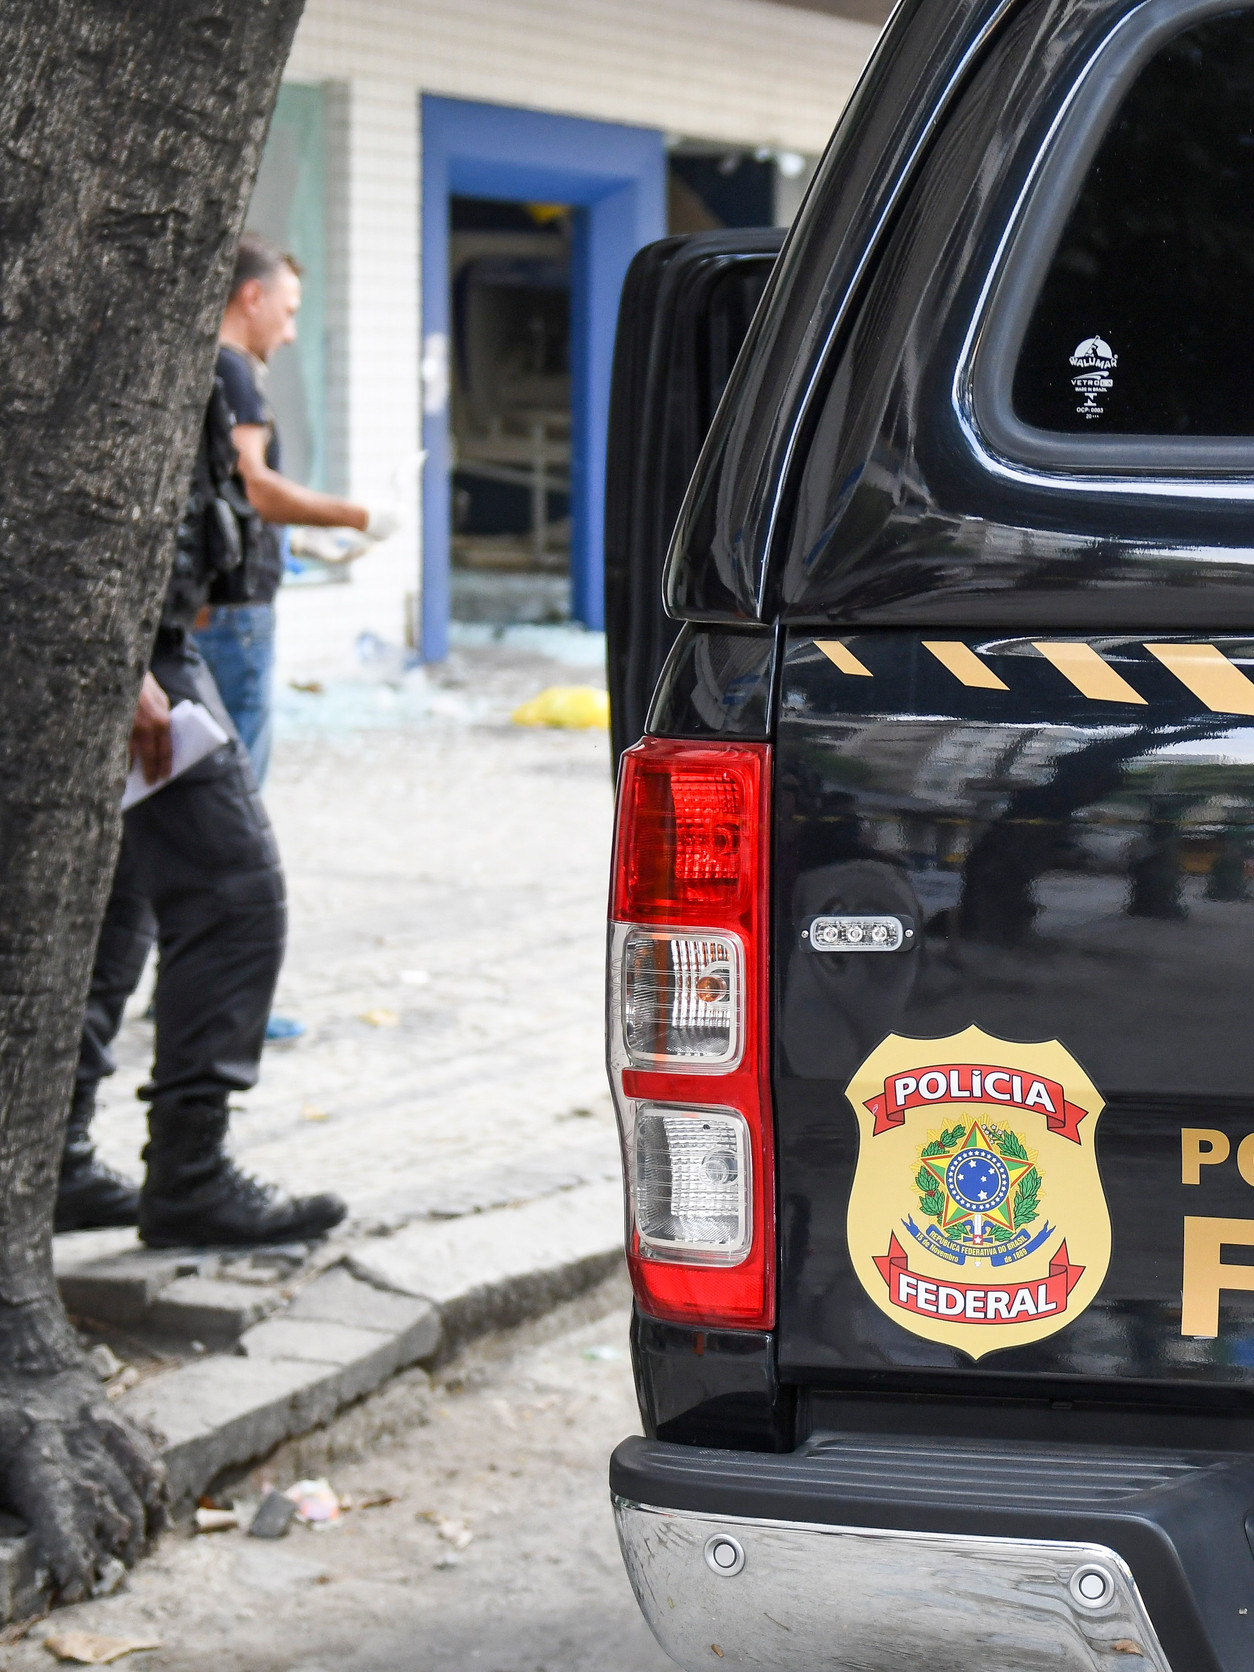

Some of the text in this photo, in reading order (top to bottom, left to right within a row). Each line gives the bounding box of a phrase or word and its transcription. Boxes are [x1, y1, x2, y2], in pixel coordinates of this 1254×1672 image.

[1069, 355, 1117, 369] WALUMAR
[894, 1069, 1056, 1113] POLÍCIA
[915, 1232, 1028, 1263] 15 de Novembro de 1889
[961, 1246, 997, 1257] FEDERATIVA
[998, 1245, 1006, 1253] DO
[1007, 1235, 1027, 1250] BRASIL
[898, 1272, 1057, 1320] FEDERAL
